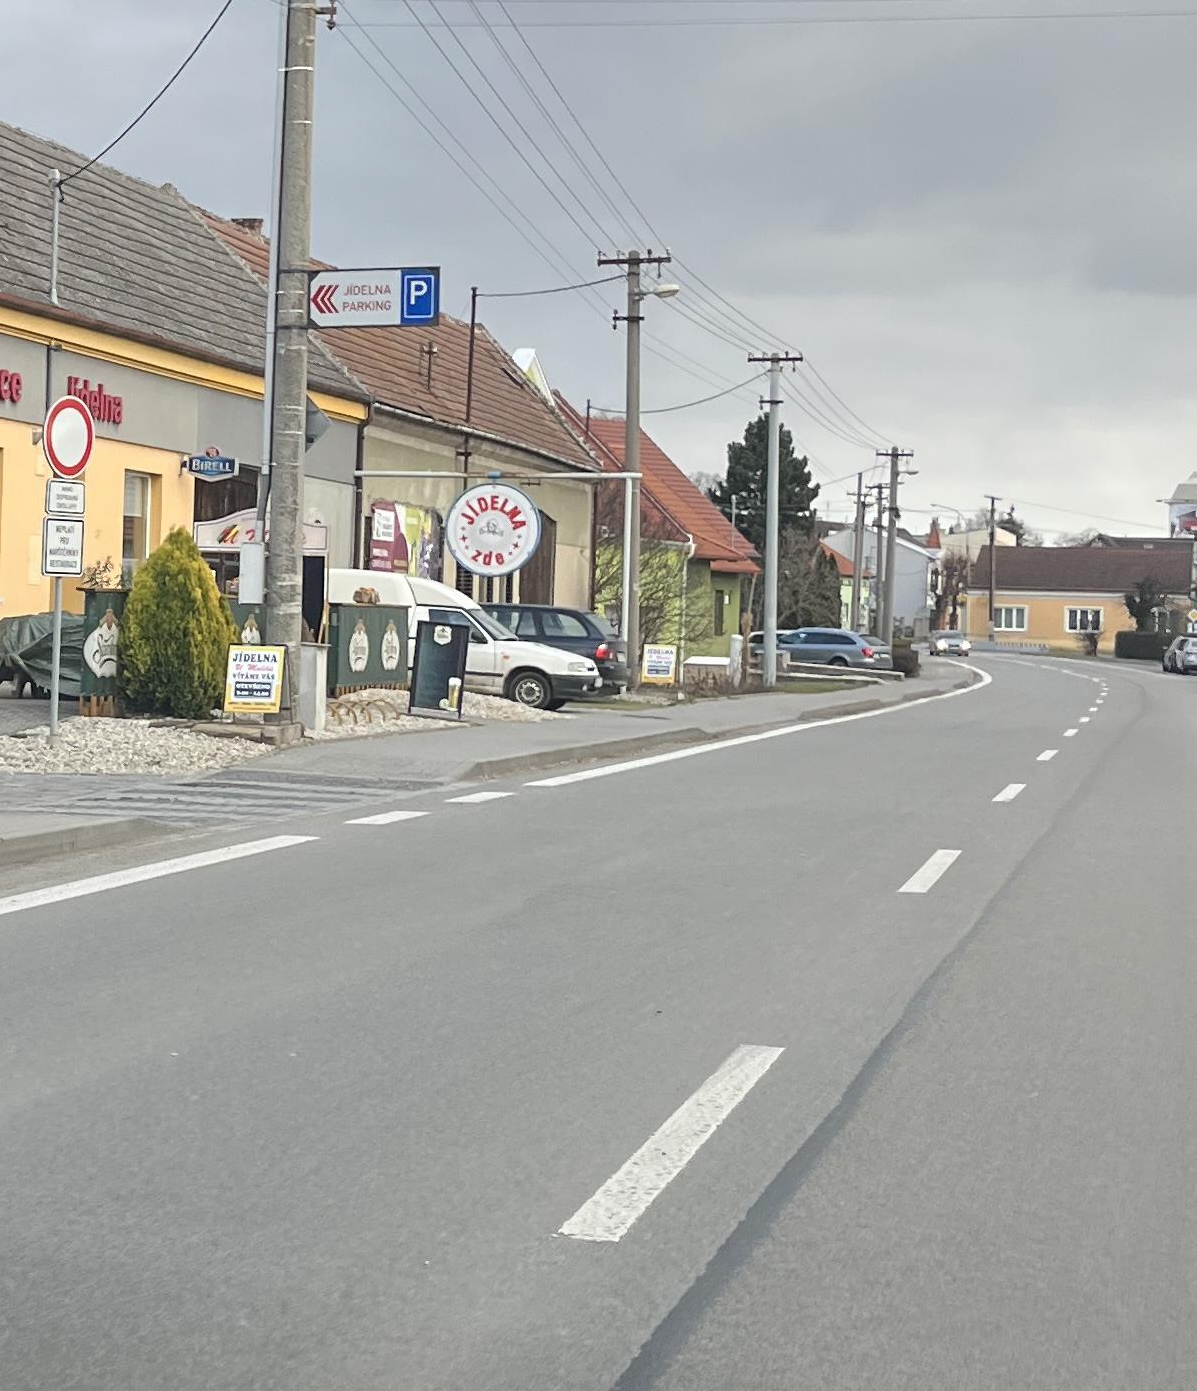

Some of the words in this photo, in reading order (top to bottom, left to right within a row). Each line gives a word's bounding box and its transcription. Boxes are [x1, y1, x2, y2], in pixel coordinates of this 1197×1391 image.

[343, 282, 392, 296] JÍDELNA
[410, 280, 428, 305] P
[342, 300, 392, 312] PARKING
[192, 459, 231, 472] BIRELL
[460, 495, 527, 531] JÍDELNA
[471, 549, 505, 566] zde
[232, 651, 277, 663] JÍDELNA
